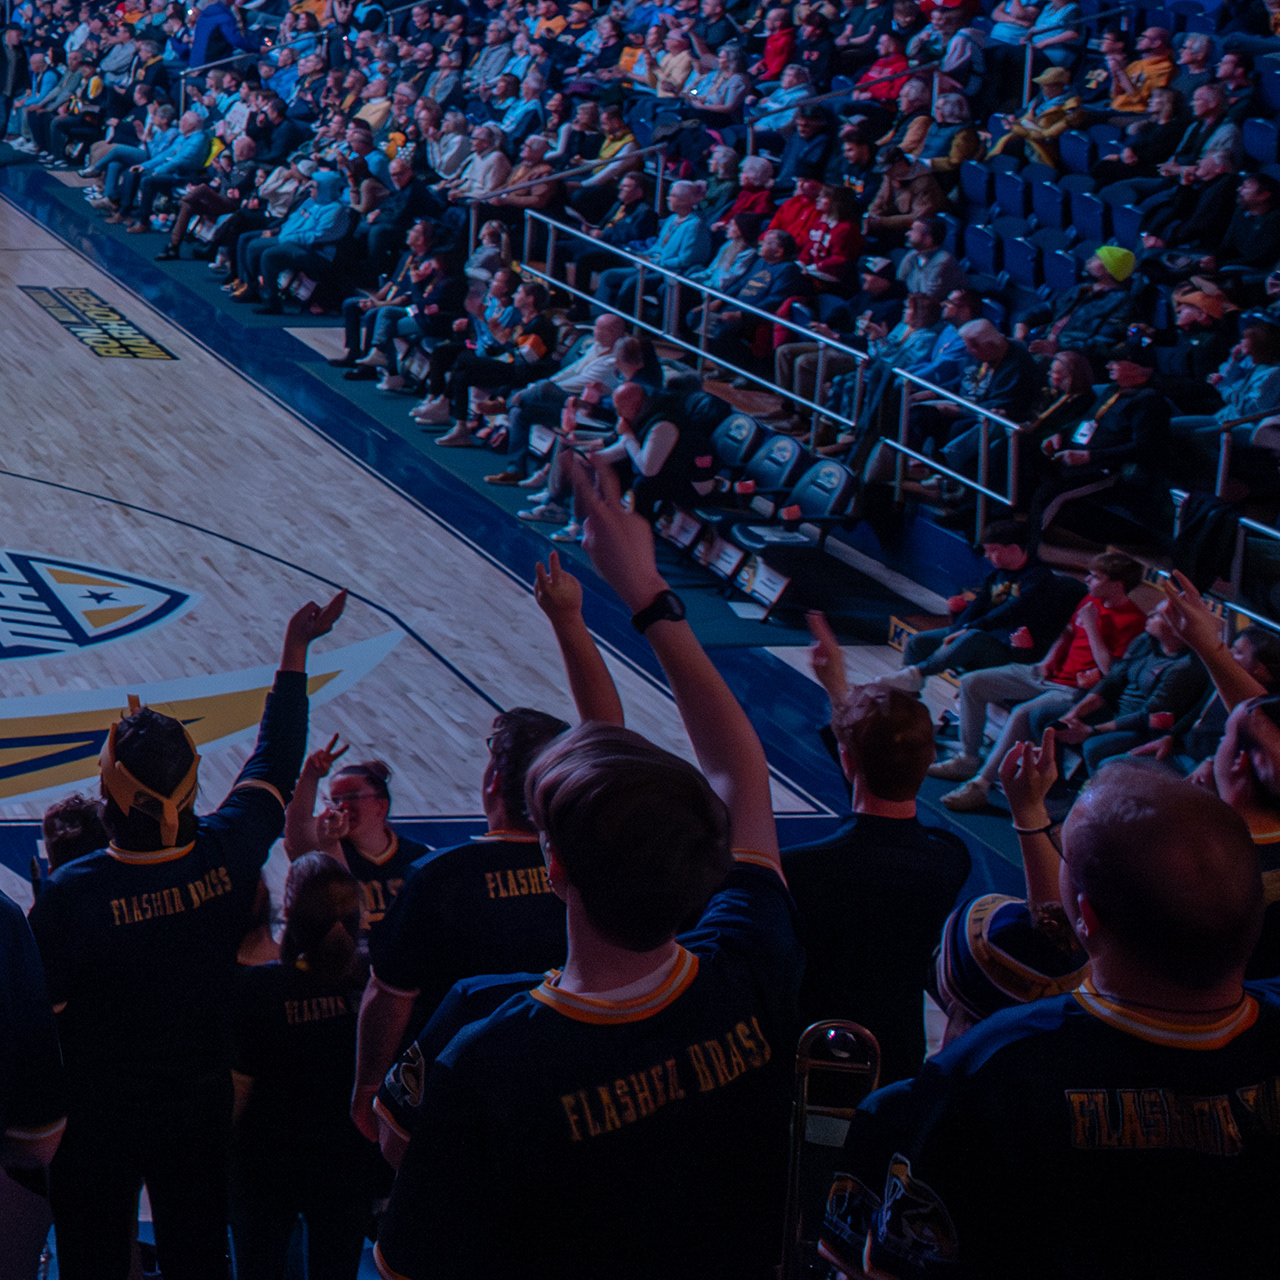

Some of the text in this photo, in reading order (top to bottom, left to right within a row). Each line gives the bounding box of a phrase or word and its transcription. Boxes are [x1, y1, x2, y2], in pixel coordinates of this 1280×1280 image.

[53, 287, 178, 360] MARHOFER
[67, 326, 138, 359] RON
[109, 883, 187, 926] FLASHER
[558, 1064, 685, 1143] FLASHER
